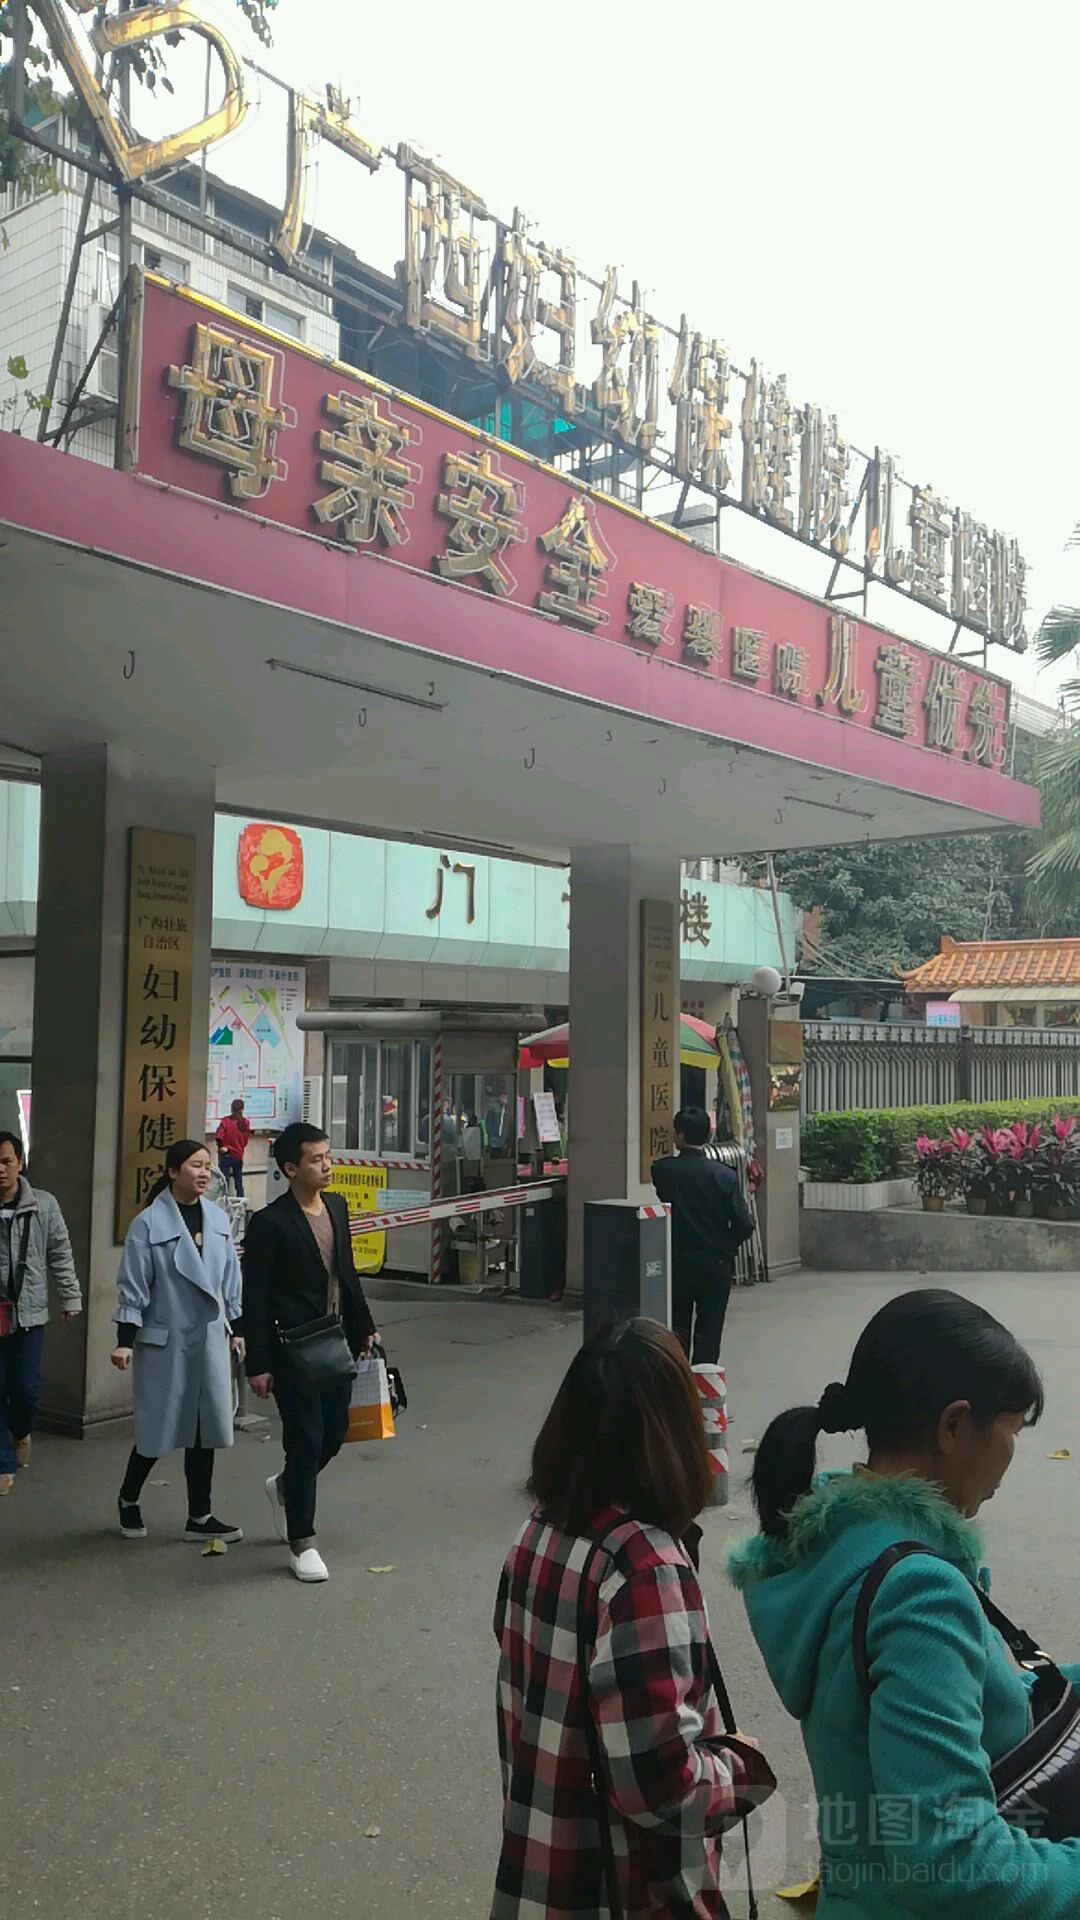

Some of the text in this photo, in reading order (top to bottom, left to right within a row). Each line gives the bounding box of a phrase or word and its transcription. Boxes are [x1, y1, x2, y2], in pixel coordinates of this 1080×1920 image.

[143, 934, 181, 950] 自治区
[649, 992, 671, 1157] 儿童医院
